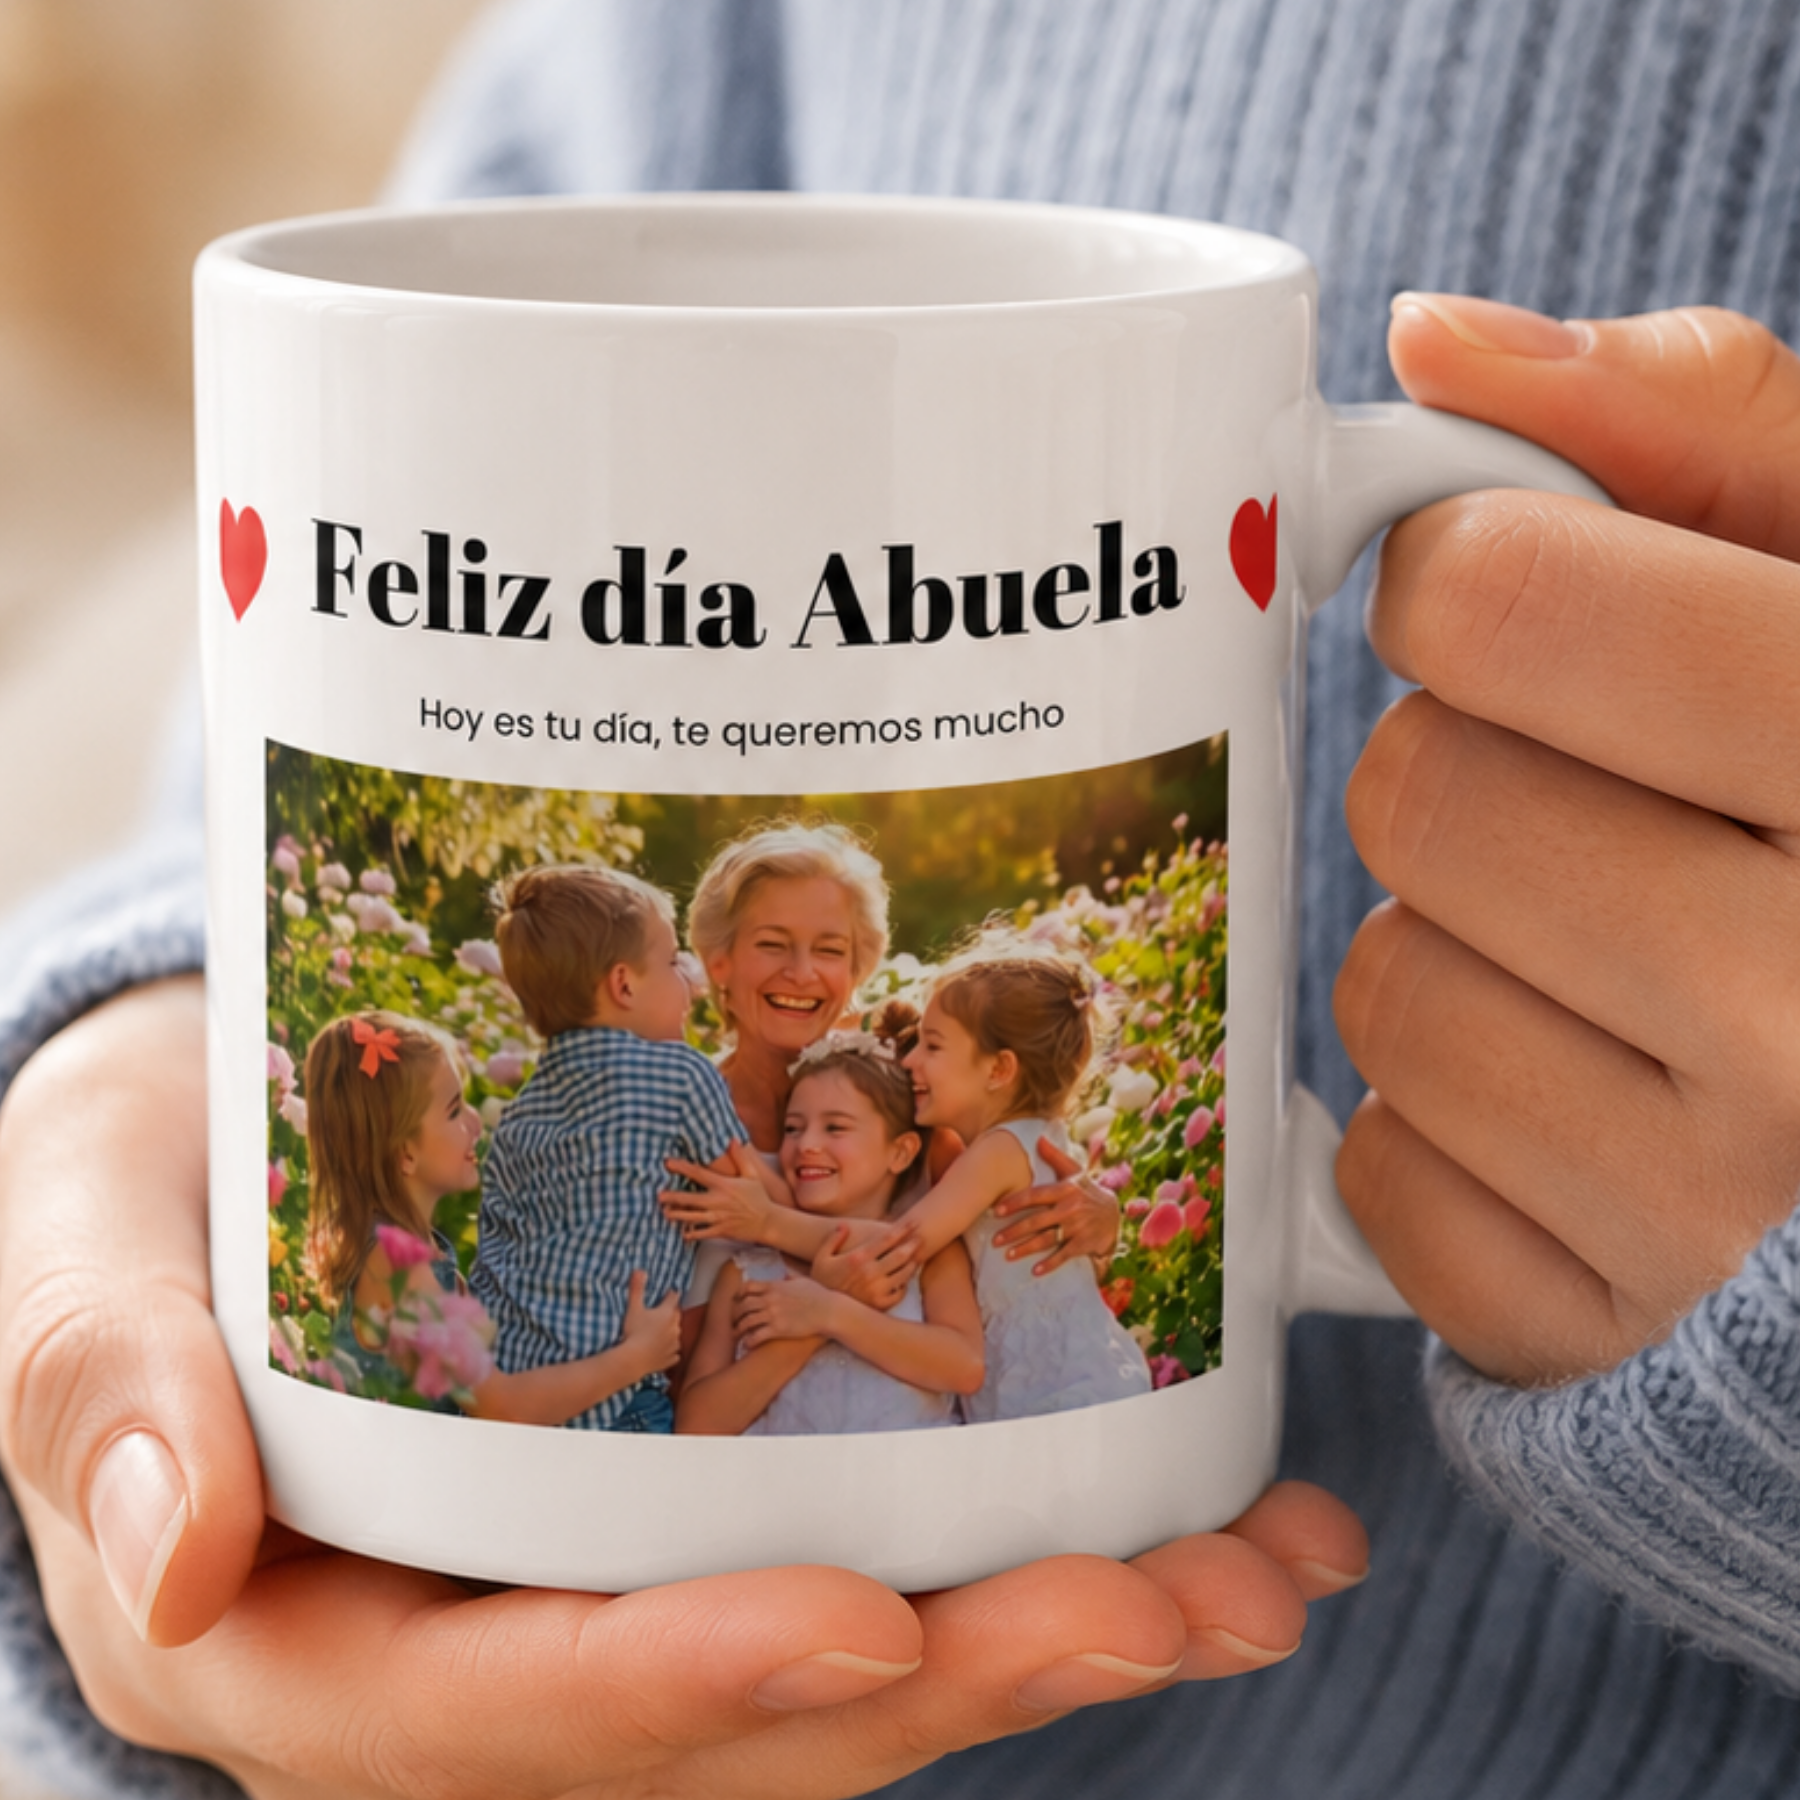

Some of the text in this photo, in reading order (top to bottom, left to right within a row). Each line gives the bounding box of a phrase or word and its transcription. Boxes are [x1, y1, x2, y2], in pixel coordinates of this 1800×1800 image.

[311, 518, 1186, 650] Feliz día Abuela
[419, 697, 1065, 757] Hoy es tu día, te queremos mucho
